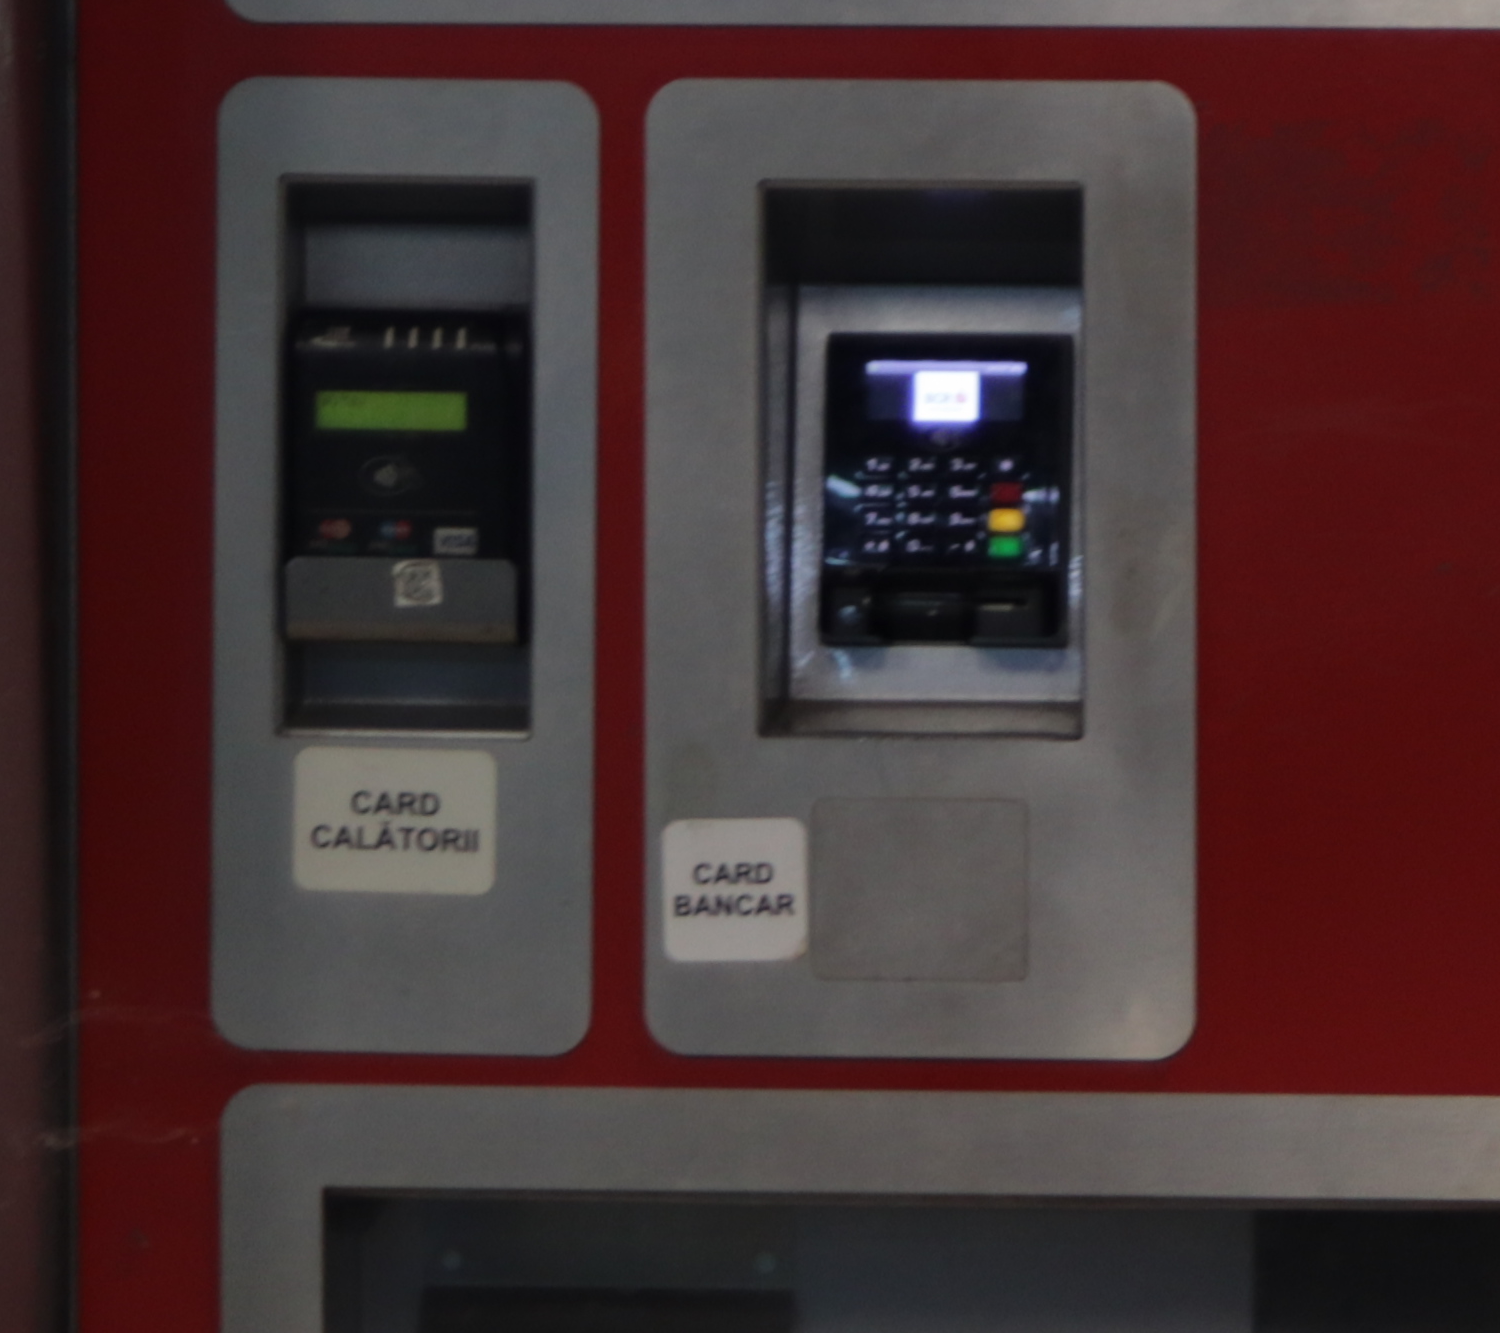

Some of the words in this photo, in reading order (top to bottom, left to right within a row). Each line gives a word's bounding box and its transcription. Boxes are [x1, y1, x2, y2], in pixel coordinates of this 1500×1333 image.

[351, 790, 441, 819] CARD
[691, 862, 775, 887] CARD
[673, 891, 796, 918] BANCAR
